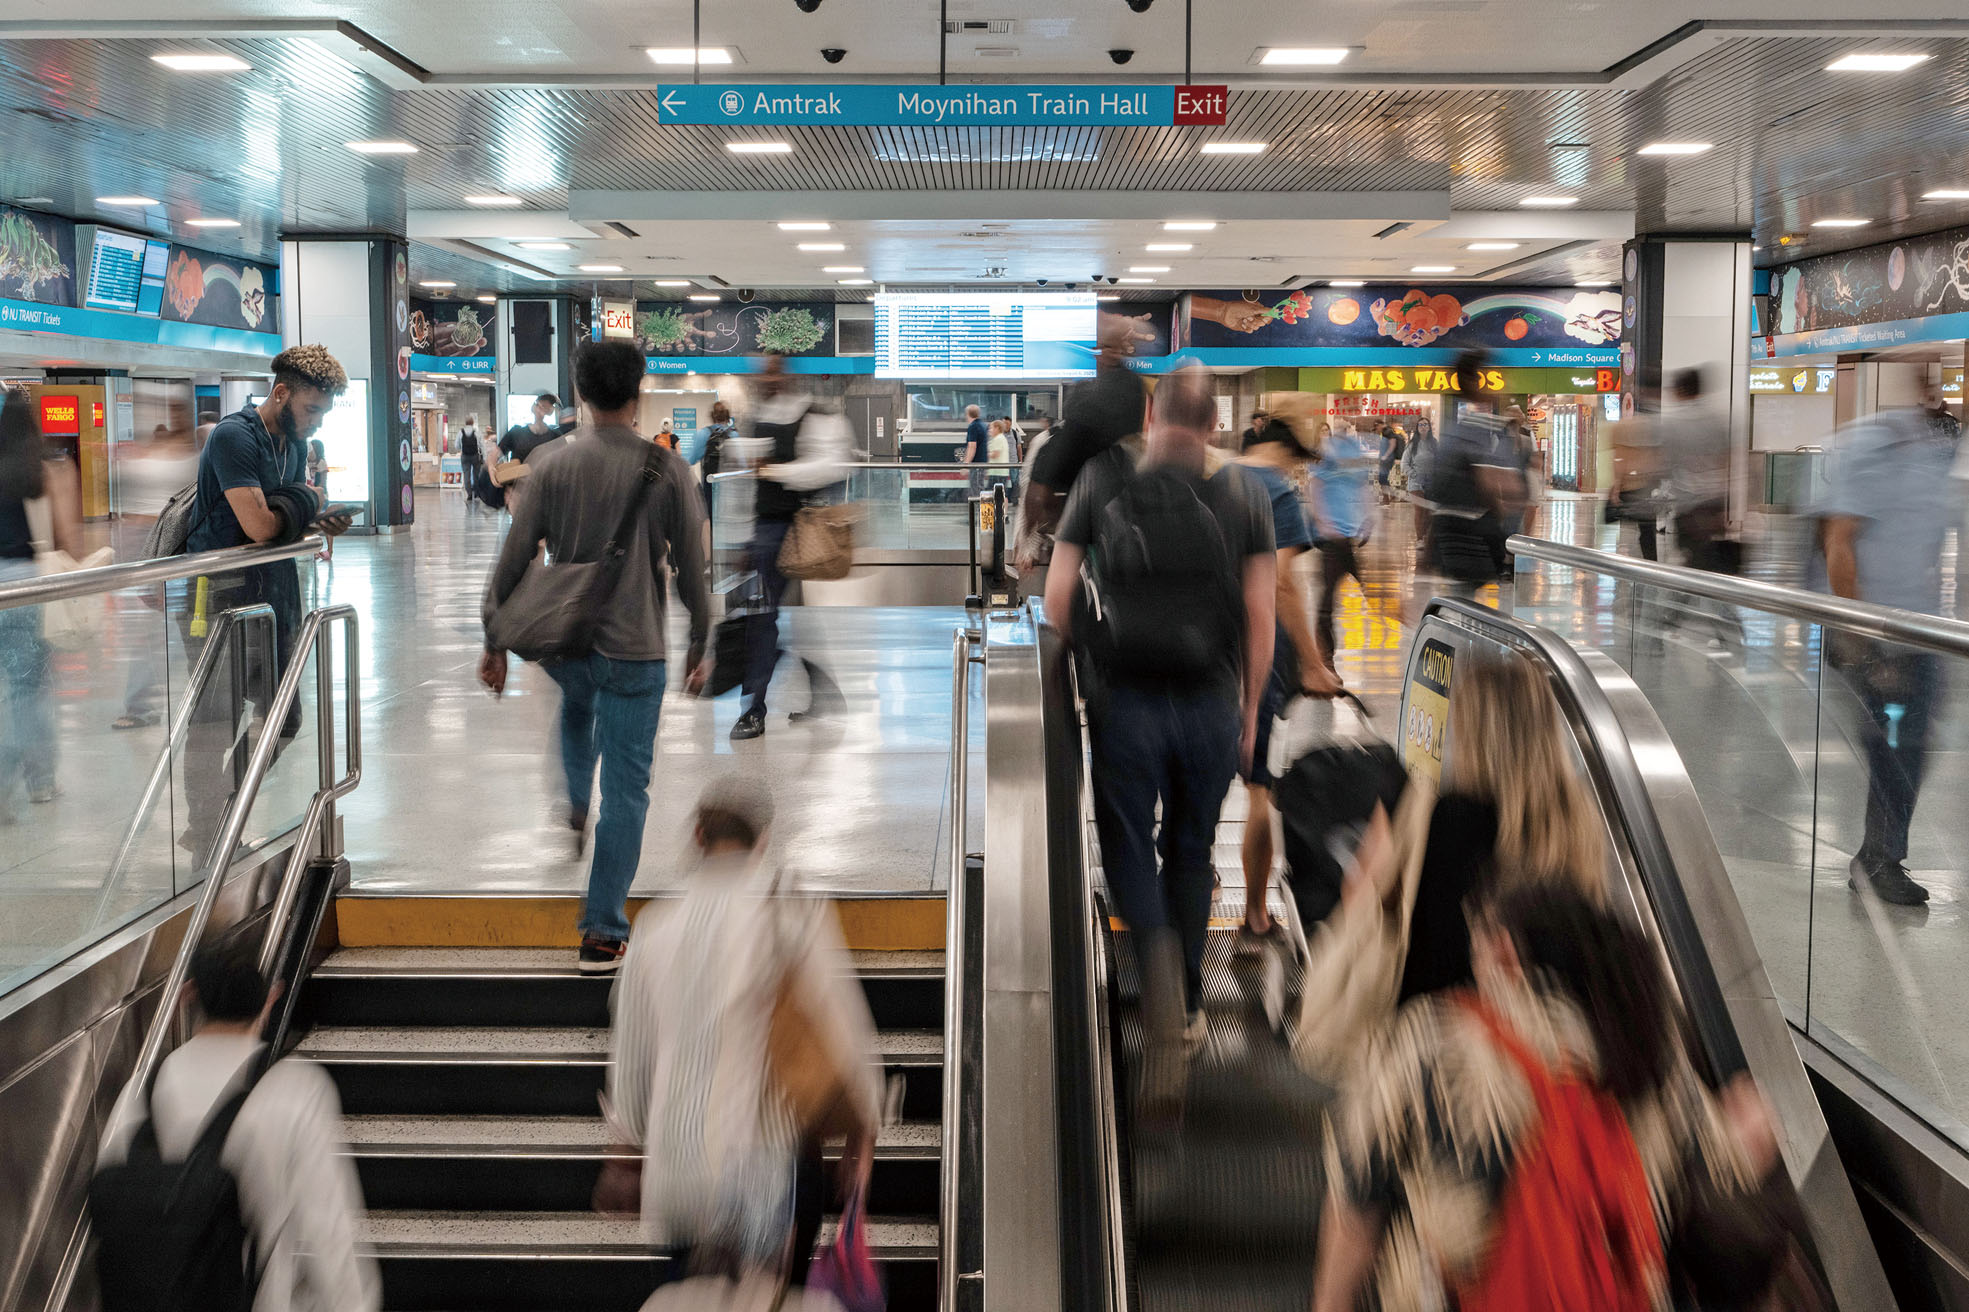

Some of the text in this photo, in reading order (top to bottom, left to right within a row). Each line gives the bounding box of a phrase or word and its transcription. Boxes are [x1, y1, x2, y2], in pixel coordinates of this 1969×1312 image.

[753, 92, 842, 114] Amtrak
[898, 92, 1148, 122] Moynihan Train Hall
[1177, 92, 1223, 115] Exit
[9, 308, 61, 326] NJ TRANSIT Tickets
[607, 310, 632, 329] Exit
[1877, 331, 1894, 342] Waiting
[1895, 329, 1906, 339] Area
[472, 361, 489, 369] LIRR
[659, 361, 687, 369] Women
[1136, 361, 1153, 369] Men
[1548, 353, 1583, 362] Madison
[1586, 353, 1614, 363] Square
[1344, 370, 1406, 391] MAS
[1334, 397, 1379, 408] FRESH
[1366, 408, 1421, 416] TORTILLAS
[1422, 647, 1454, 688] CAUTION
